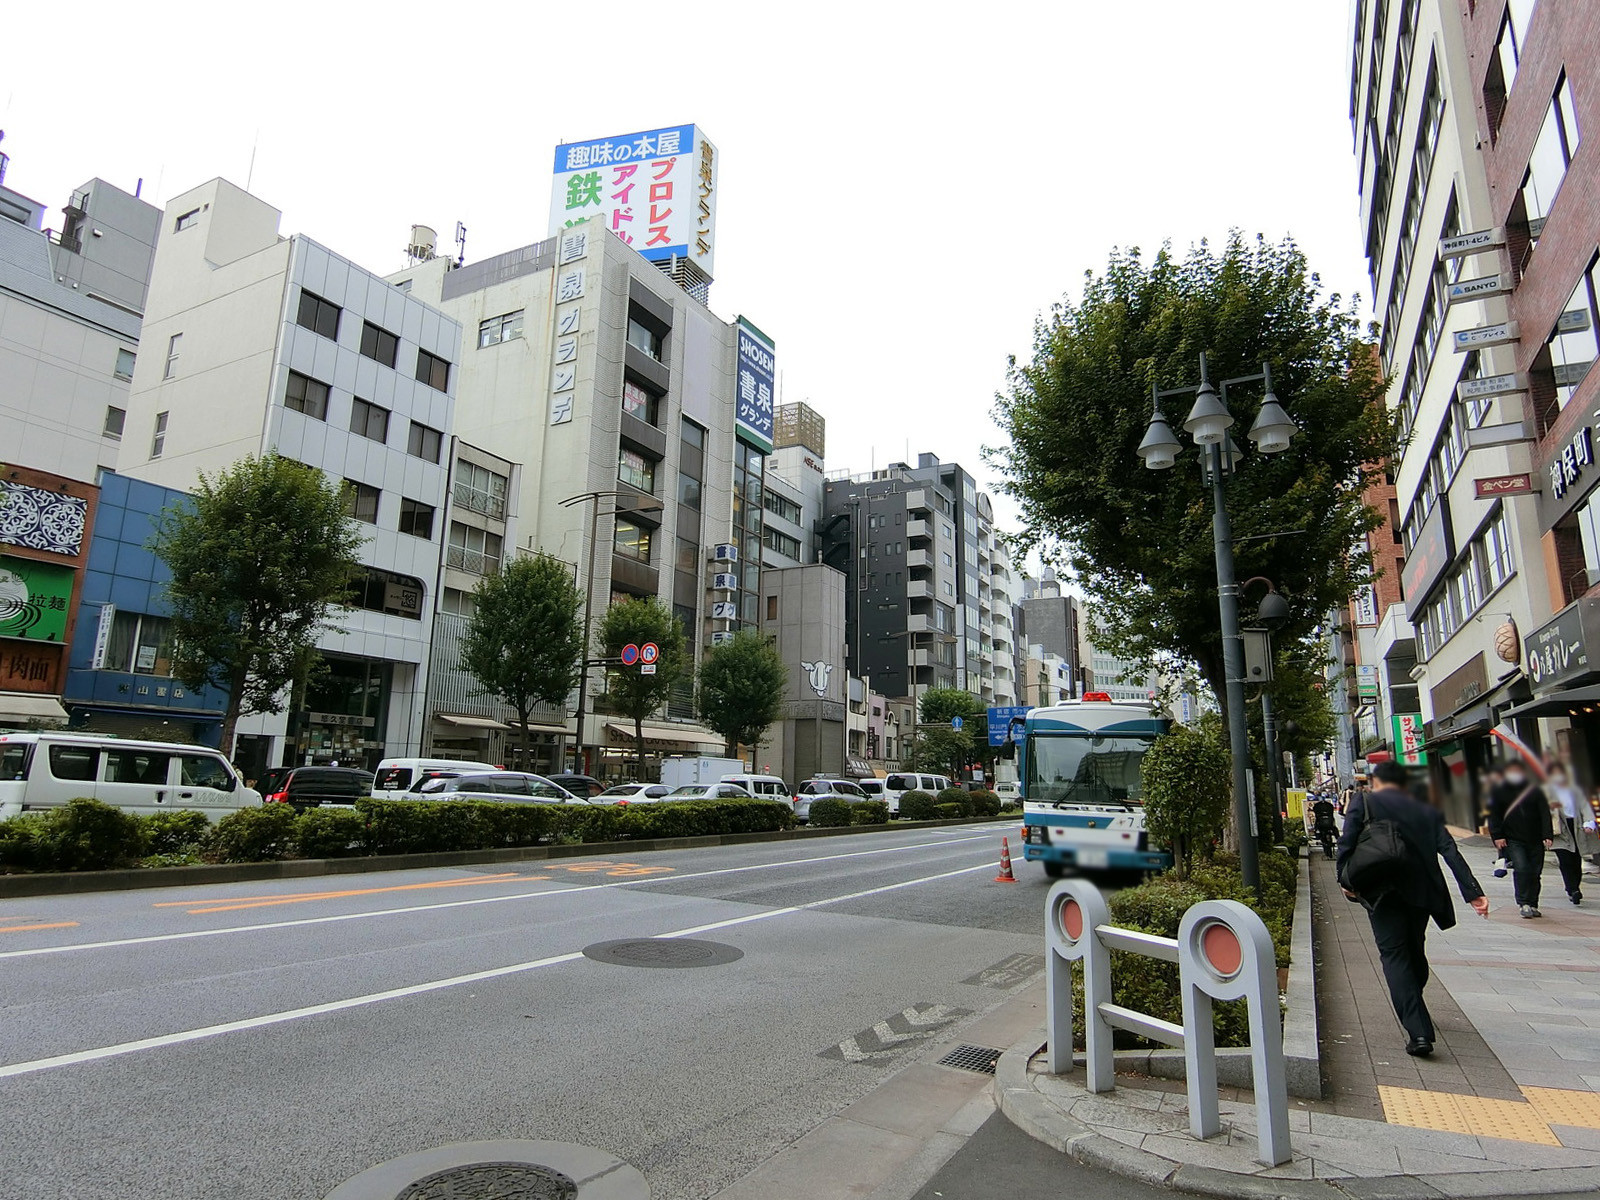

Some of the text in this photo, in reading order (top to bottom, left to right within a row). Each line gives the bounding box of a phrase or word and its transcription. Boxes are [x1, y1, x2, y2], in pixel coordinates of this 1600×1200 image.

[565, 130, 681, 170] 趣味の本屋
[565, 171, 603, 229] 鉄
[645, 157, 677, 246] プロレス
[1463, 281, 1497, 294] SANYO
[552, 232, 586, 423] 書泉グランデ
[740, 336, 774, 373] SHOSEN
[739, 369, 773, 414] 書泉
[1482, 478, 1525, 491] 金ペン堂
[0, 653, 49, 682] 肉面
